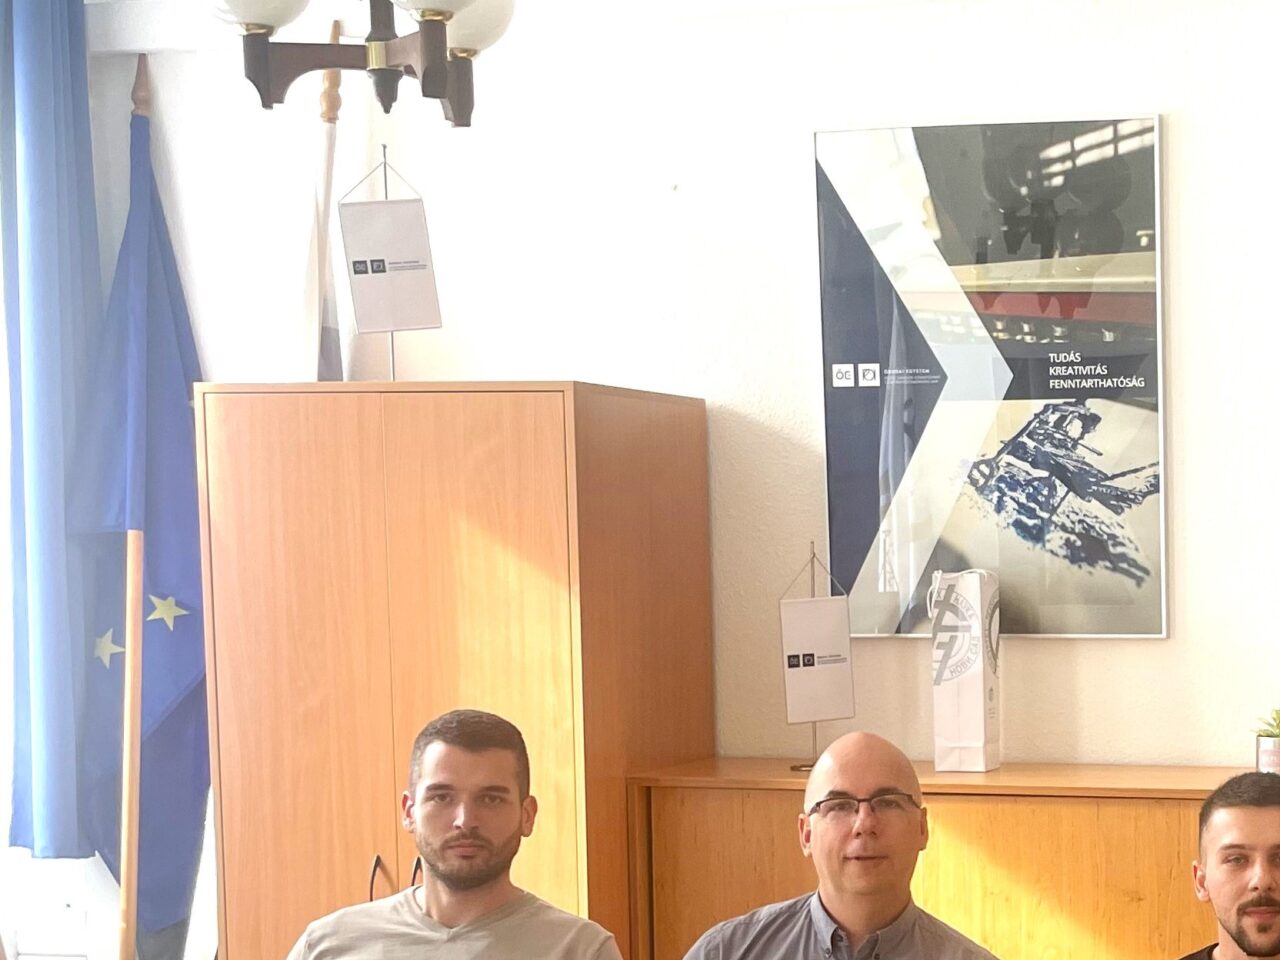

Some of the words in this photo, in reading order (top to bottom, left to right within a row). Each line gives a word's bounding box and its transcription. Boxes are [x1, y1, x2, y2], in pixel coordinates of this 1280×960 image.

[1048, 350, 1081, 363] TUDÁS
[1049, 363, 1108, 376] KREATIVITÁS
[1049, 375, 1145, 389] FENNTARTHATÓSÁG
